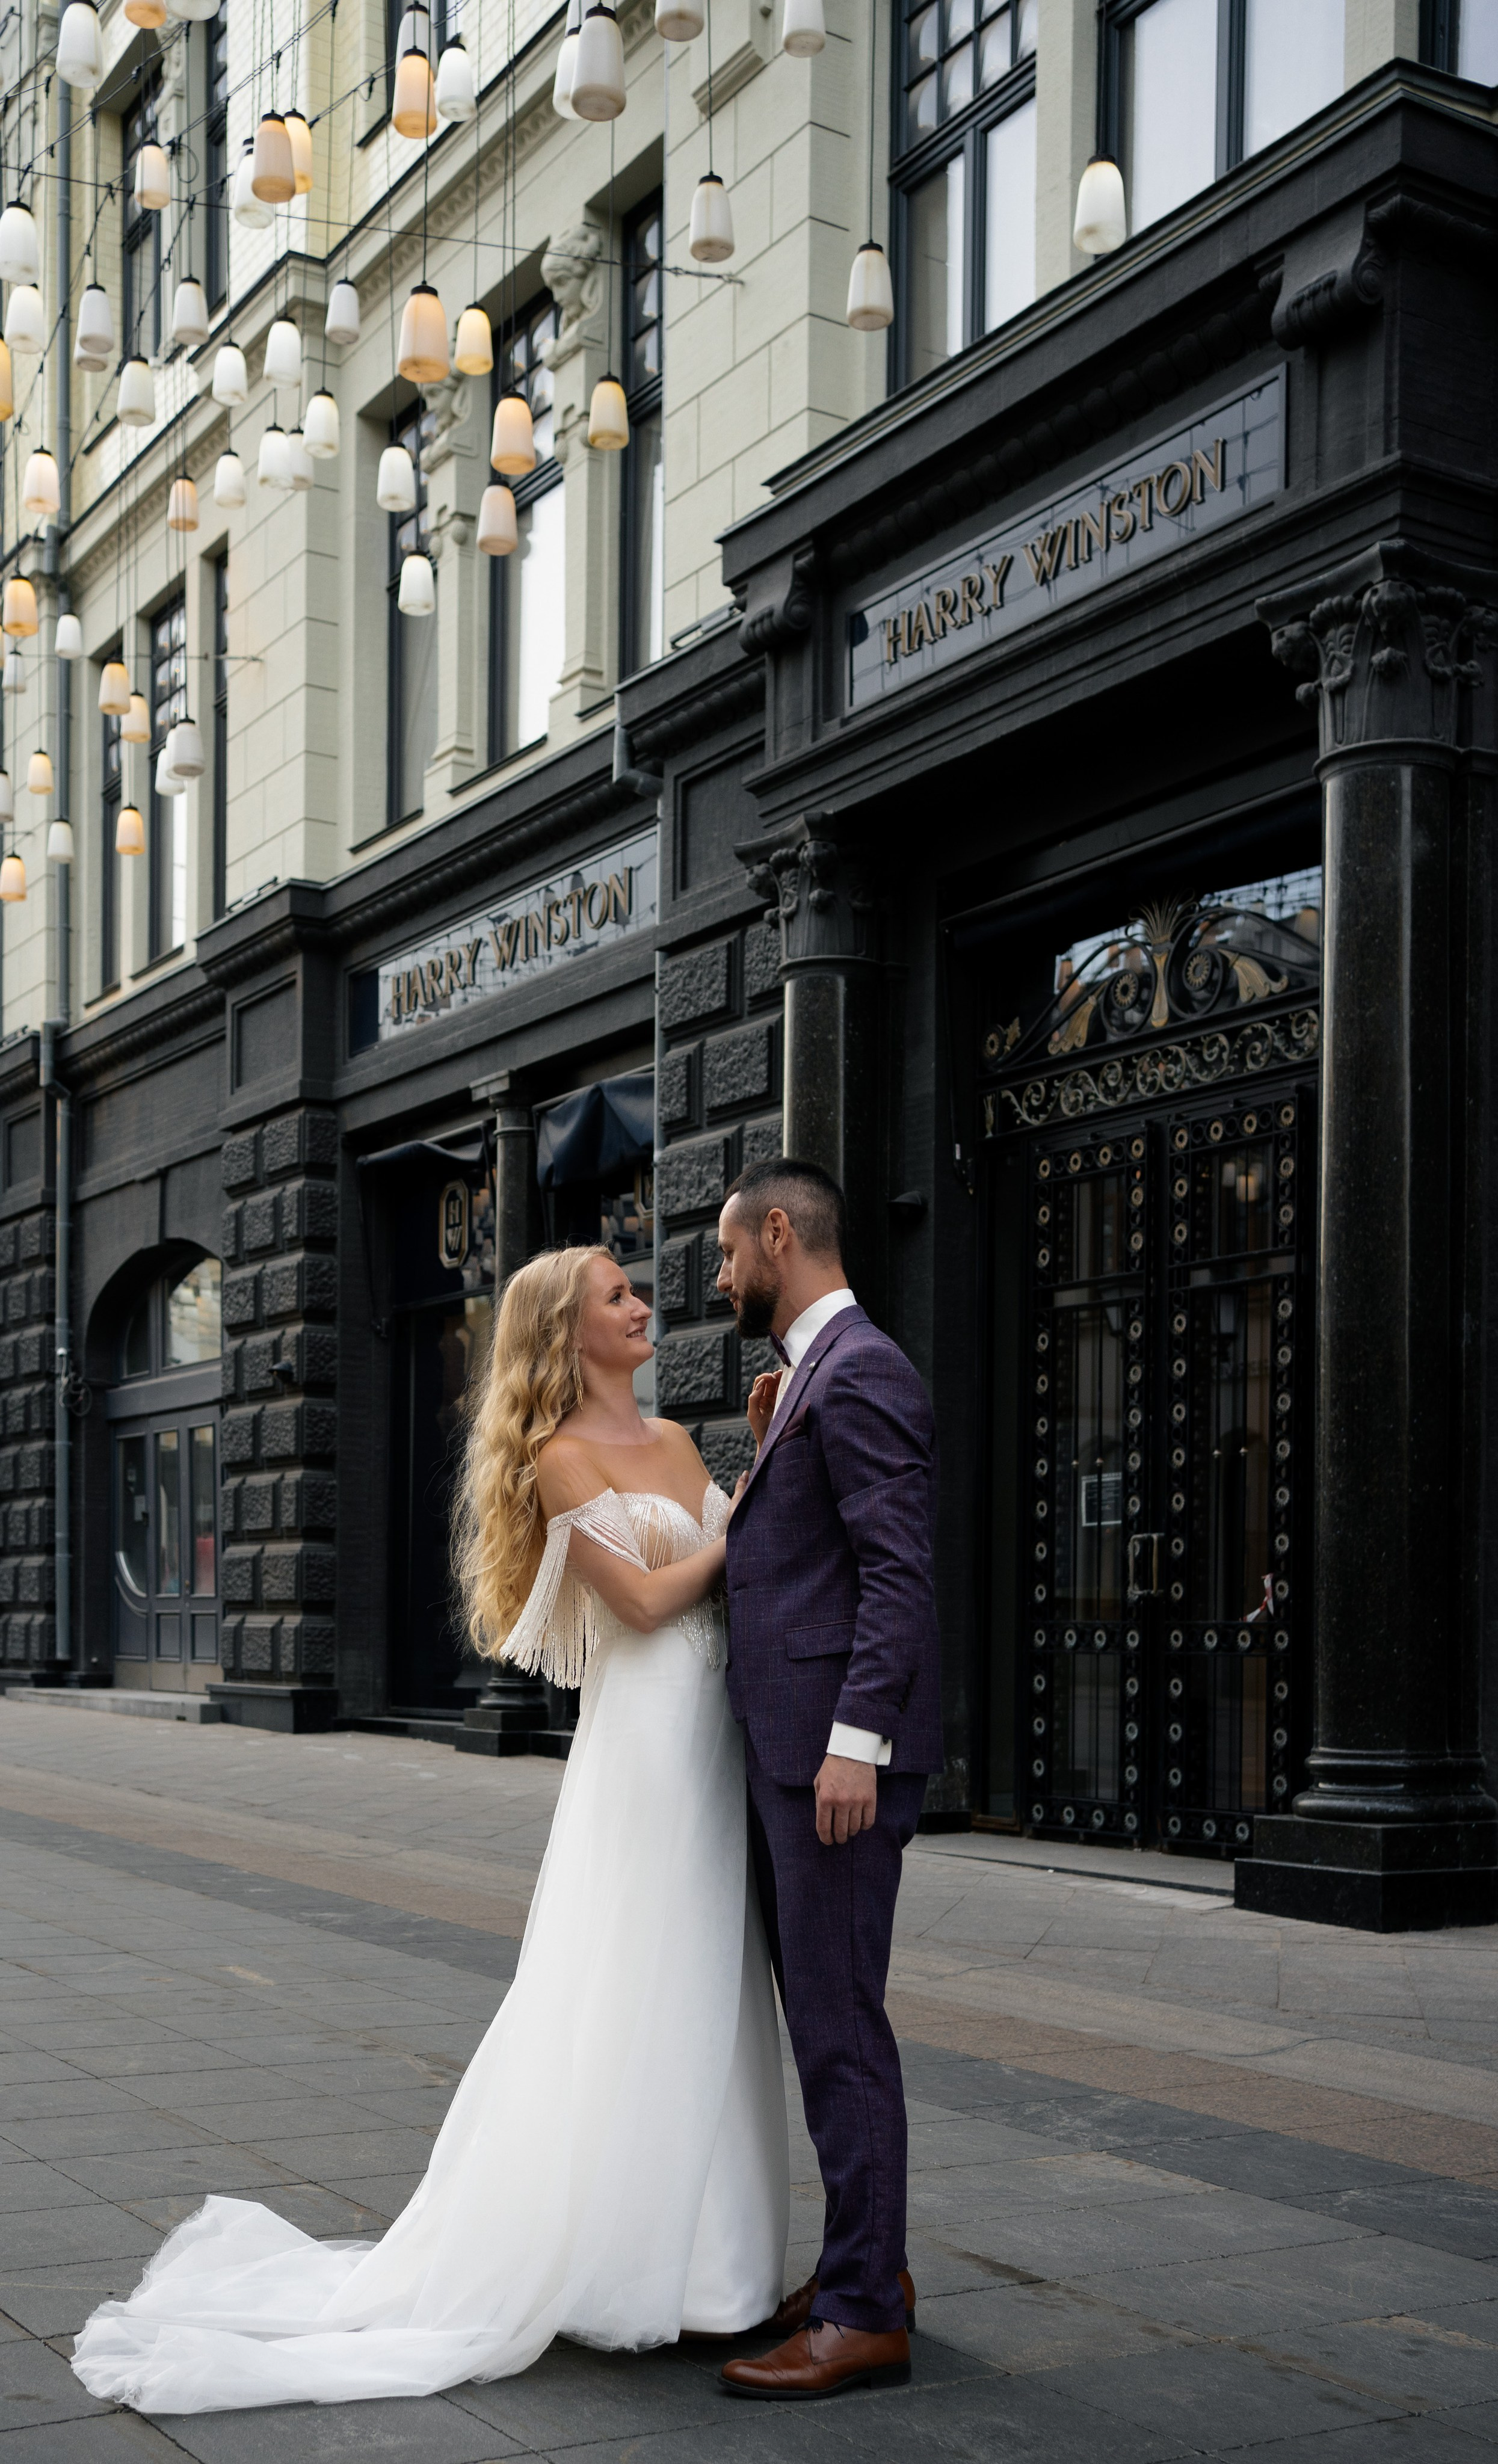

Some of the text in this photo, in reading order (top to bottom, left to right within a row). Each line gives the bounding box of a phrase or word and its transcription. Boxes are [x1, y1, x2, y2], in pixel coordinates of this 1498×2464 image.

[884, 437, 1226, 666] HARRY WINSTON
[391, 866, 632, 1018] HARRY WINSTON
